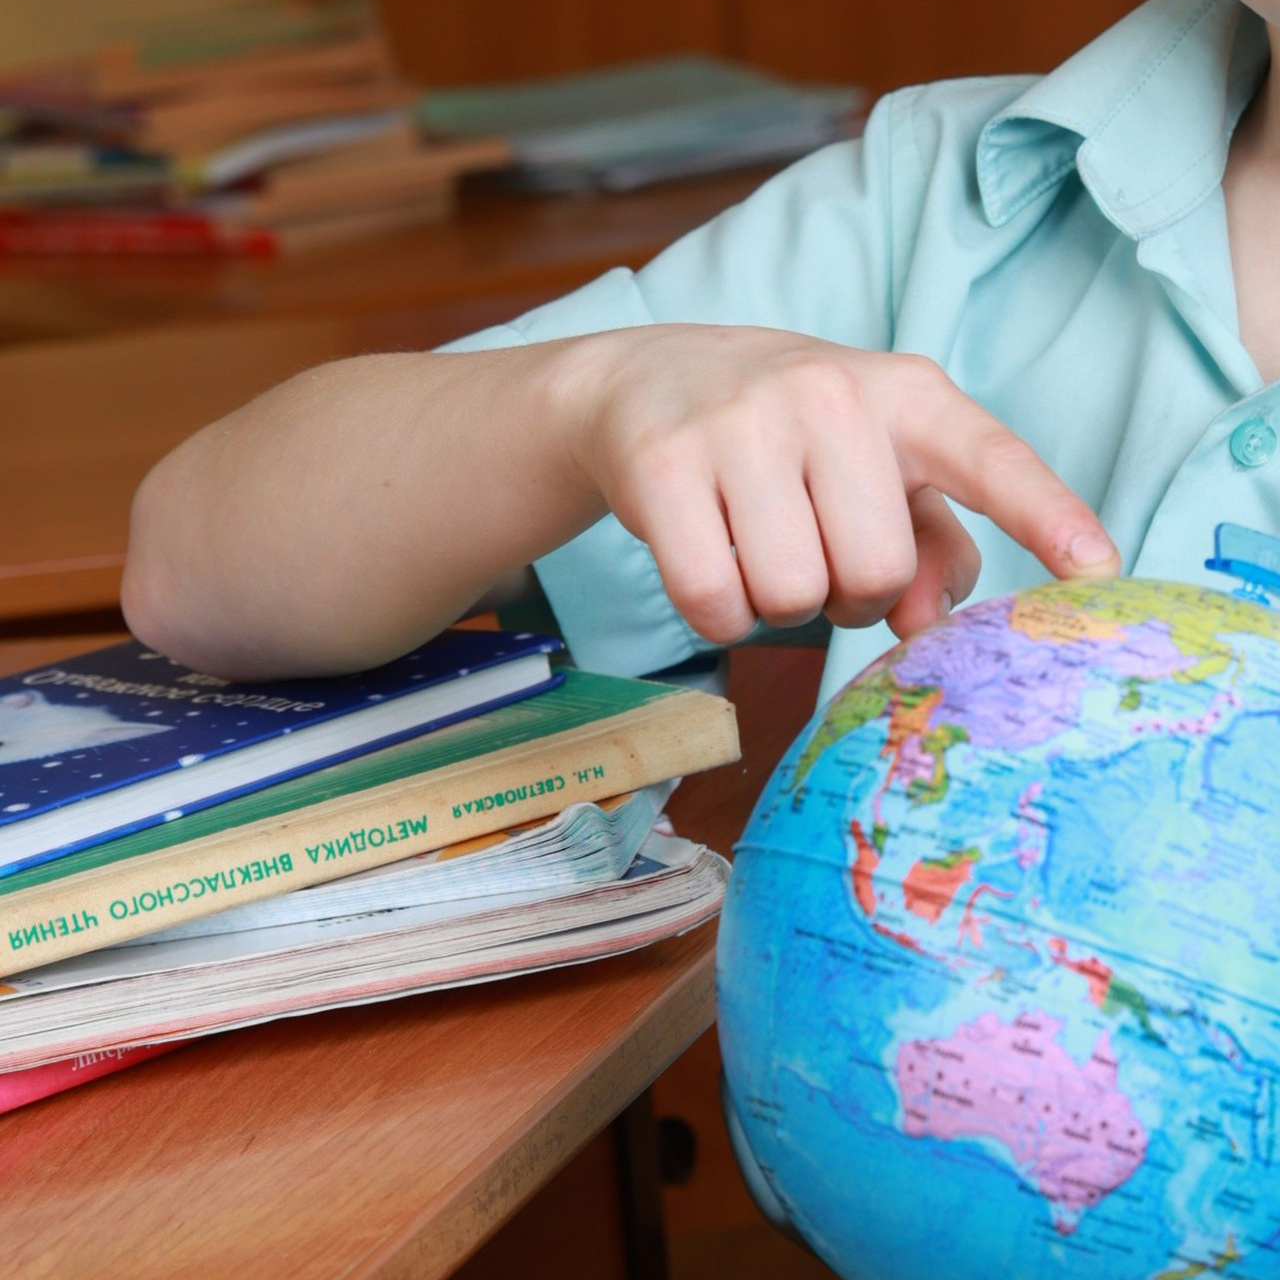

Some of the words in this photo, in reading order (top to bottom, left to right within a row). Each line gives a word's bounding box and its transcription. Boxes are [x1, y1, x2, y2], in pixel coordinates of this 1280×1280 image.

[192, 691, 327, 713] сердце
[451, 774, 566, 819] СВЕТЛОВСКАЯ
[304, 814, 429, 865] МЕТОДИКА
[108, 851, 295, 922] ВНЕКЛАССНОГО
[8, 909, 101, 952] ЧТЕНИЯ
